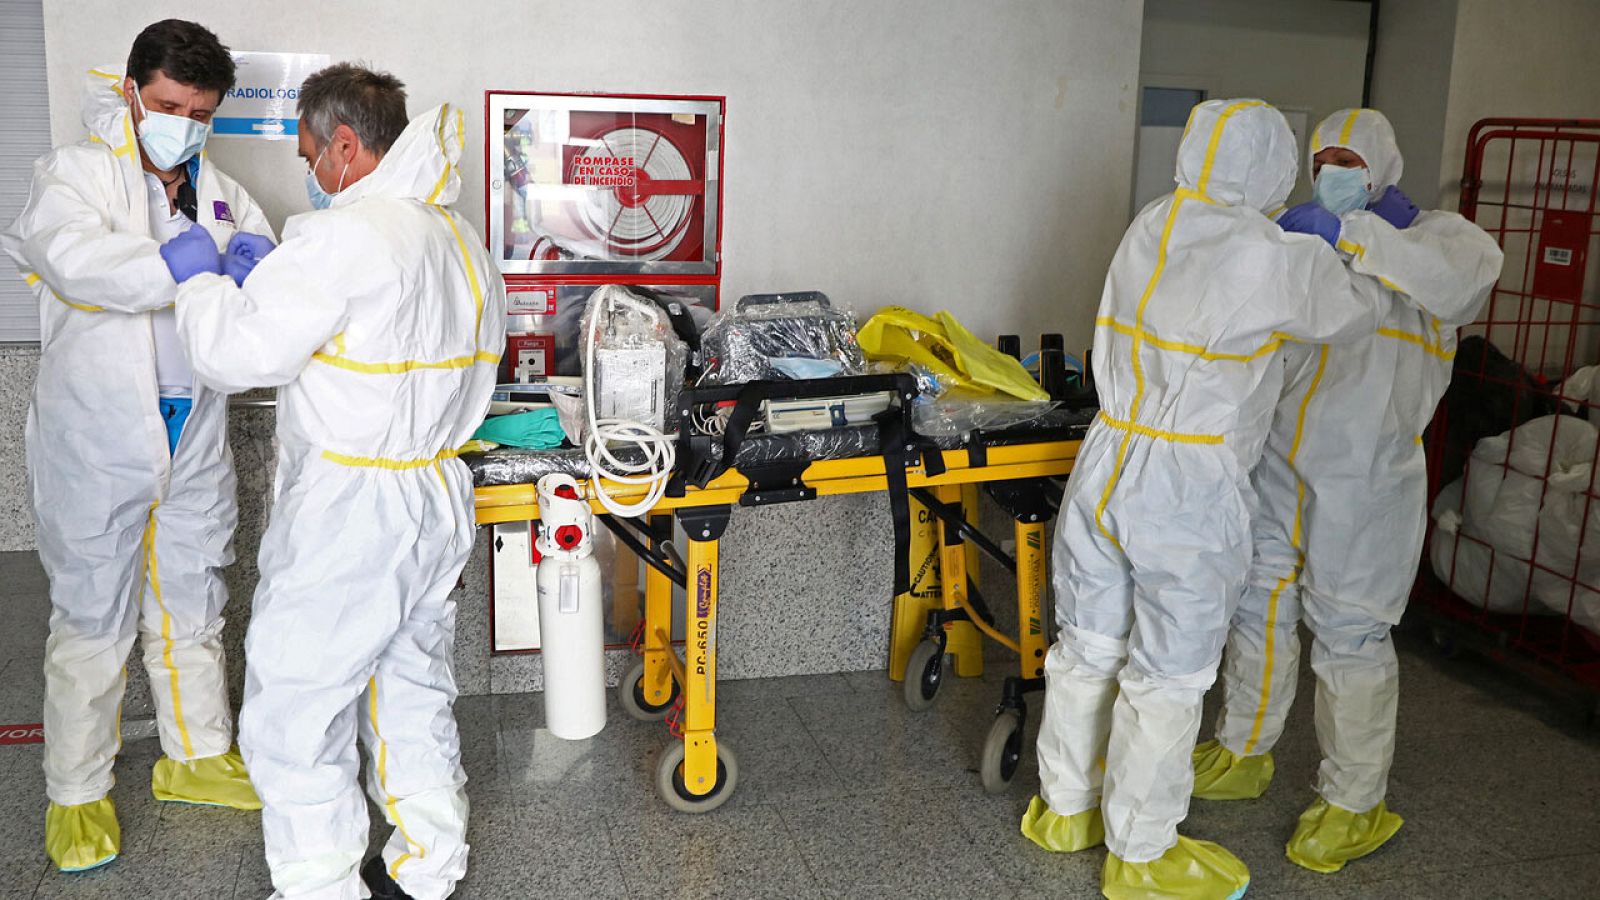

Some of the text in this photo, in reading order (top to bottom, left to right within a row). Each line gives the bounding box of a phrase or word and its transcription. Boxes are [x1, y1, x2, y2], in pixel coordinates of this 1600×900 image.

[226, 88, 301, 99] RADIOLOGI
[574, 156, 634, 166] ROMPASE
[579, 166, 630, 175] EN CASO
[574, 176, 634, 186] DE INCENDIO
[696, 620, 708, 675] PC-650
